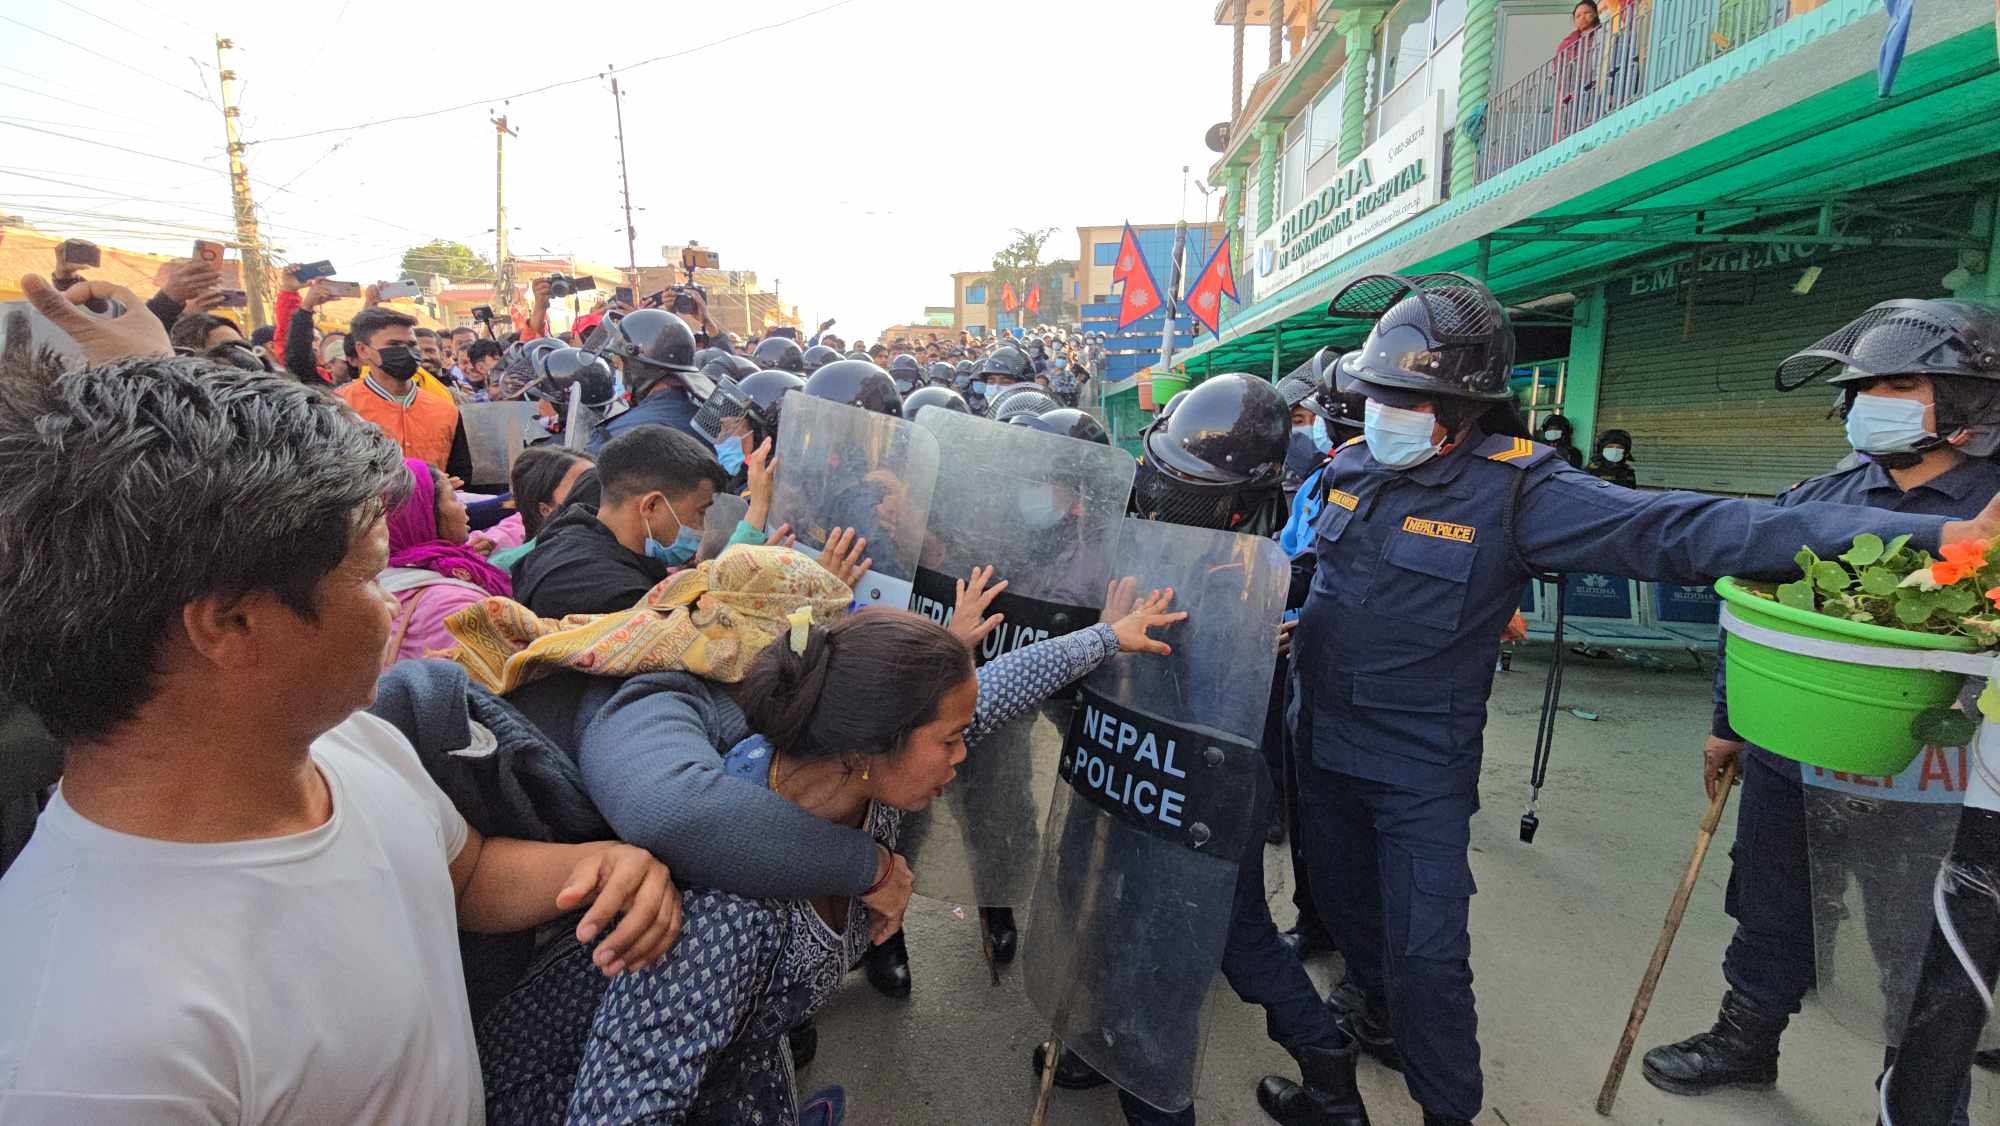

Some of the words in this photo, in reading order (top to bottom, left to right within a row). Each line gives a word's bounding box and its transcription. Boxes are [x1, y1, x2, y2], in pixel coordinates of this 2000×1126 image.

[1280, 158, 1373, 248] BUDDHA
[1356, 158, 1426, 220] HOSPITAL
[1407, 519, 1436, 537] NEPAL
[1436, 523, 1472, 540] POLICE
[910, 592, 954, 630] NEPA
[1083, 704, 1187, 779] NEPAL
[1073, 746, 1187, 828] POLICE
